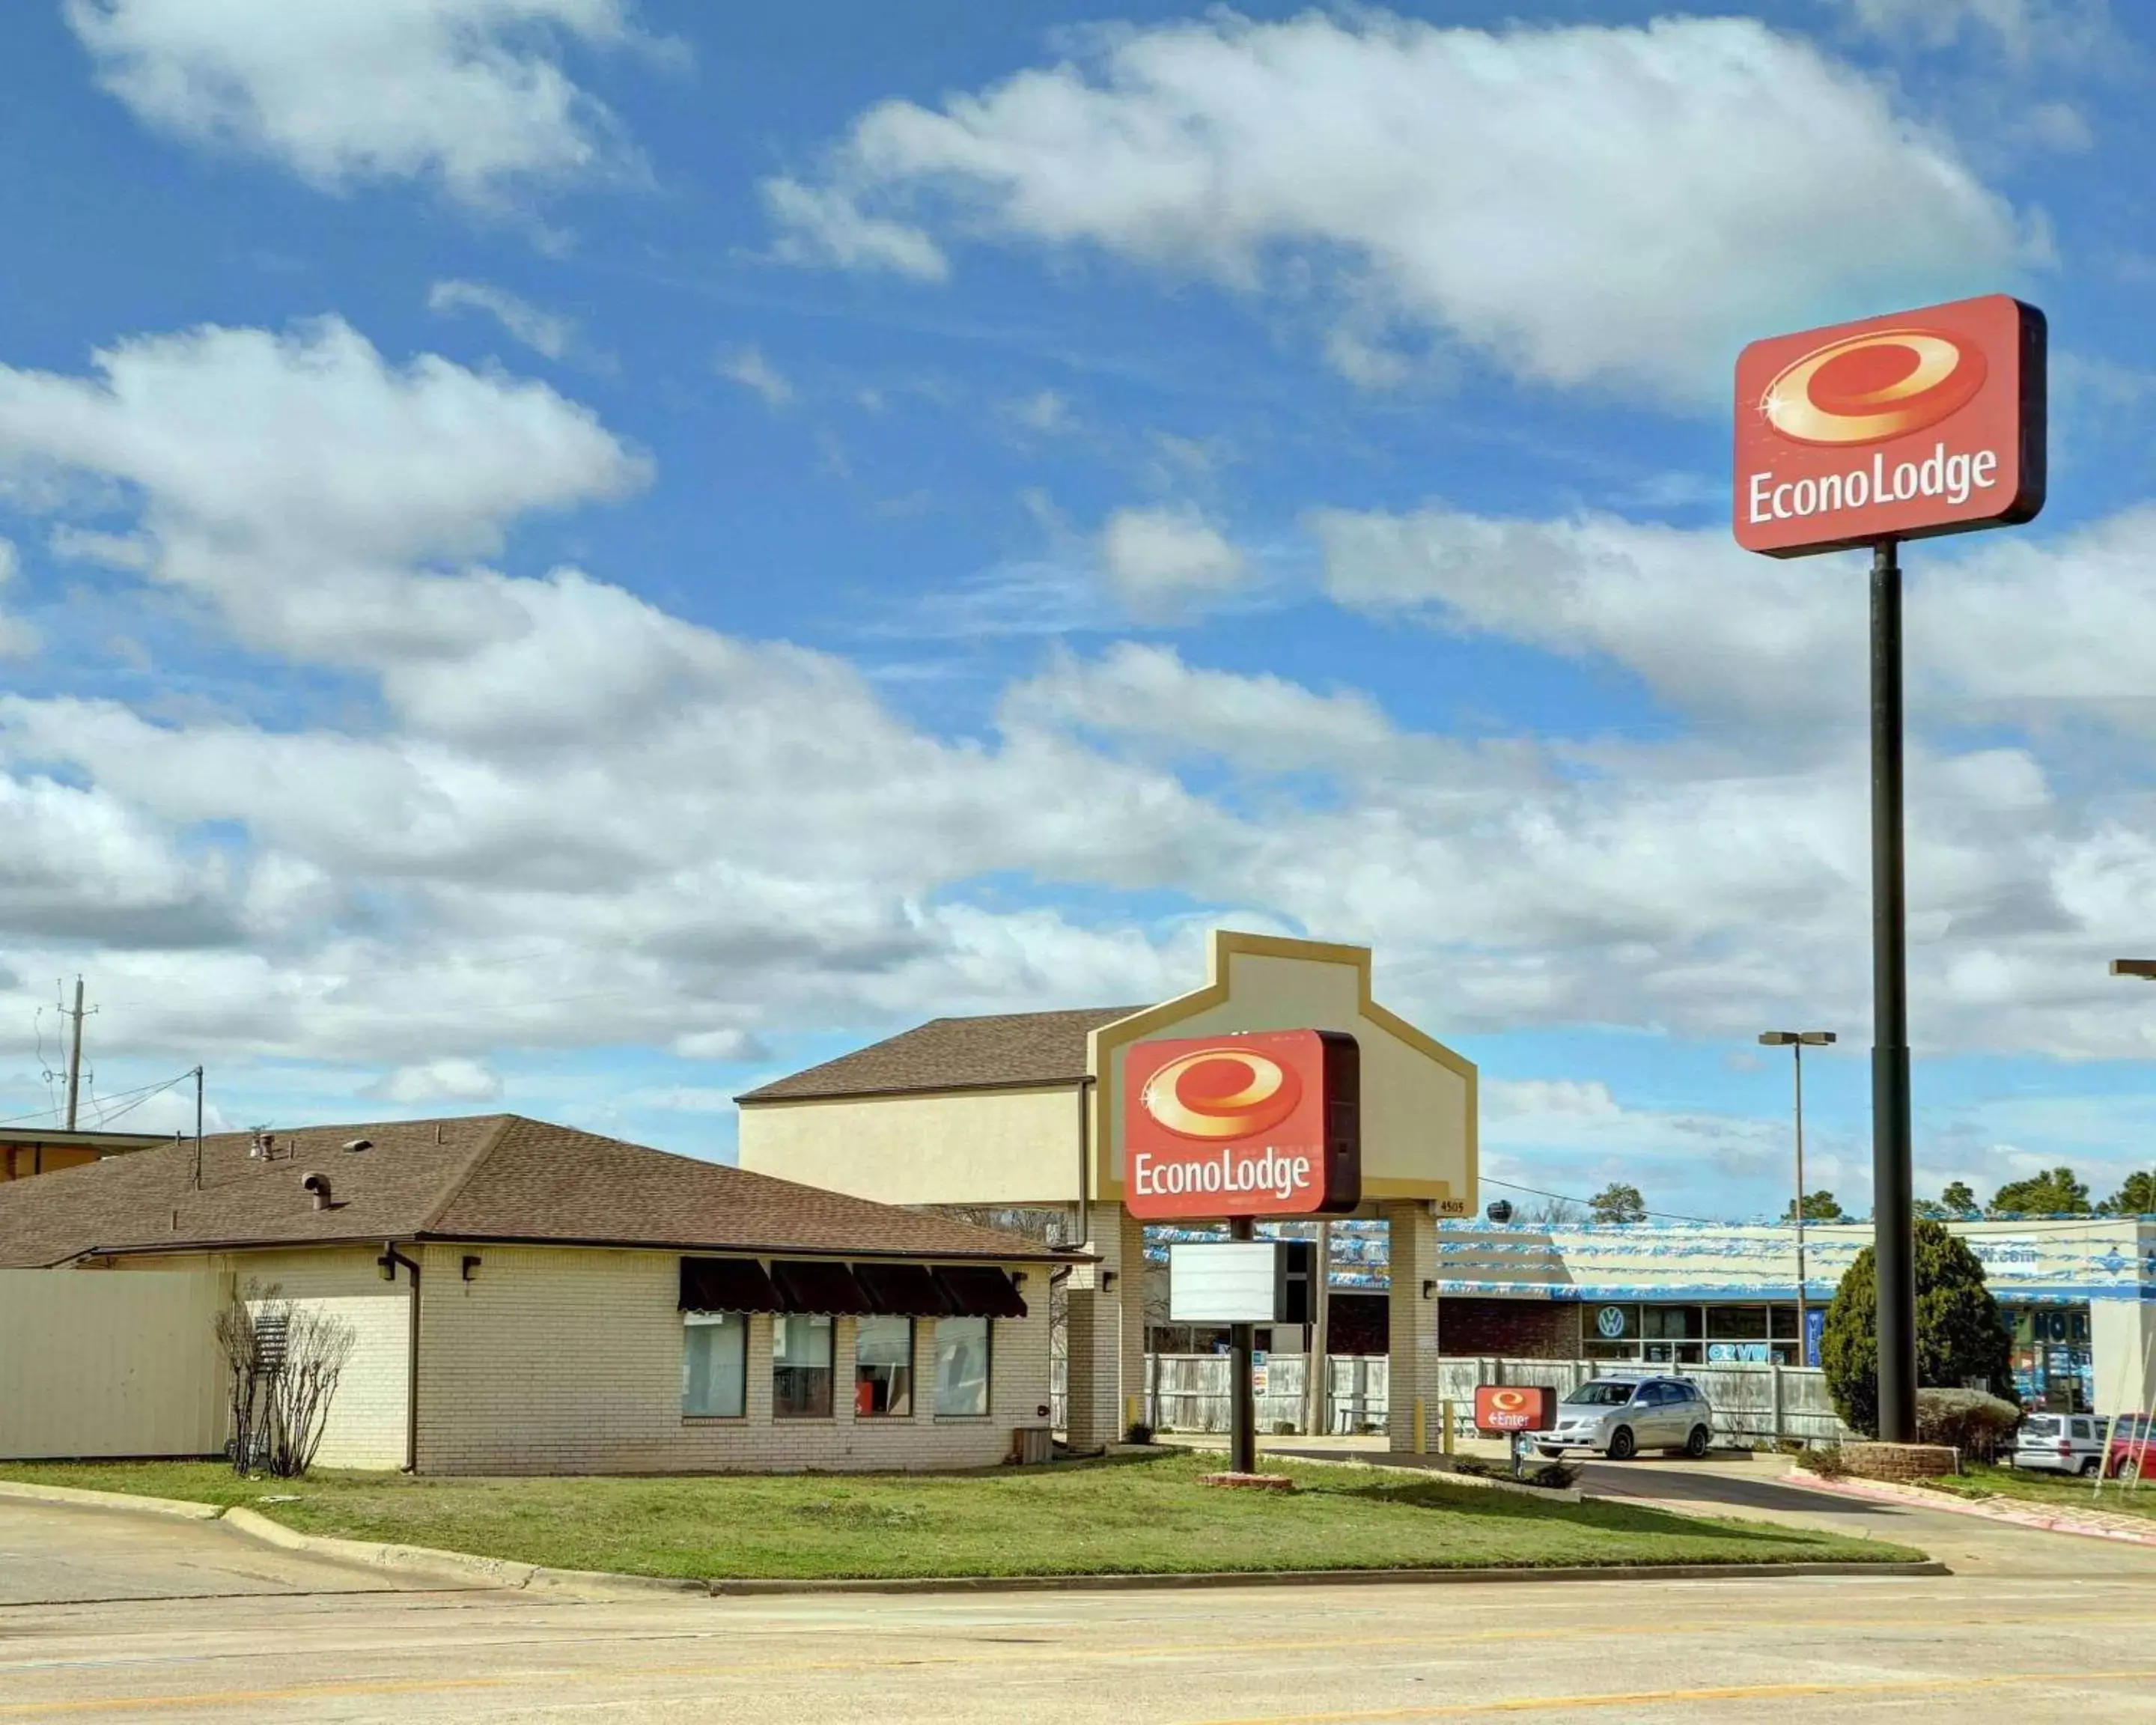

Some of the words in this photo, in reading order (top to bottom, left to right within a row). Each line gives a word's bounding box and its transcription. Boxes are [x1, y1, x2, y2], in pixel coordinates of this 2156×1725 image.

[1750, 442, 1997, 523] EconoLodge
[1135, 1146, 1310, 1199] EconoLodge
[1441, 1201, 1464, 1213] 4505
[1498, 1411, 1529, 1426] Enter
